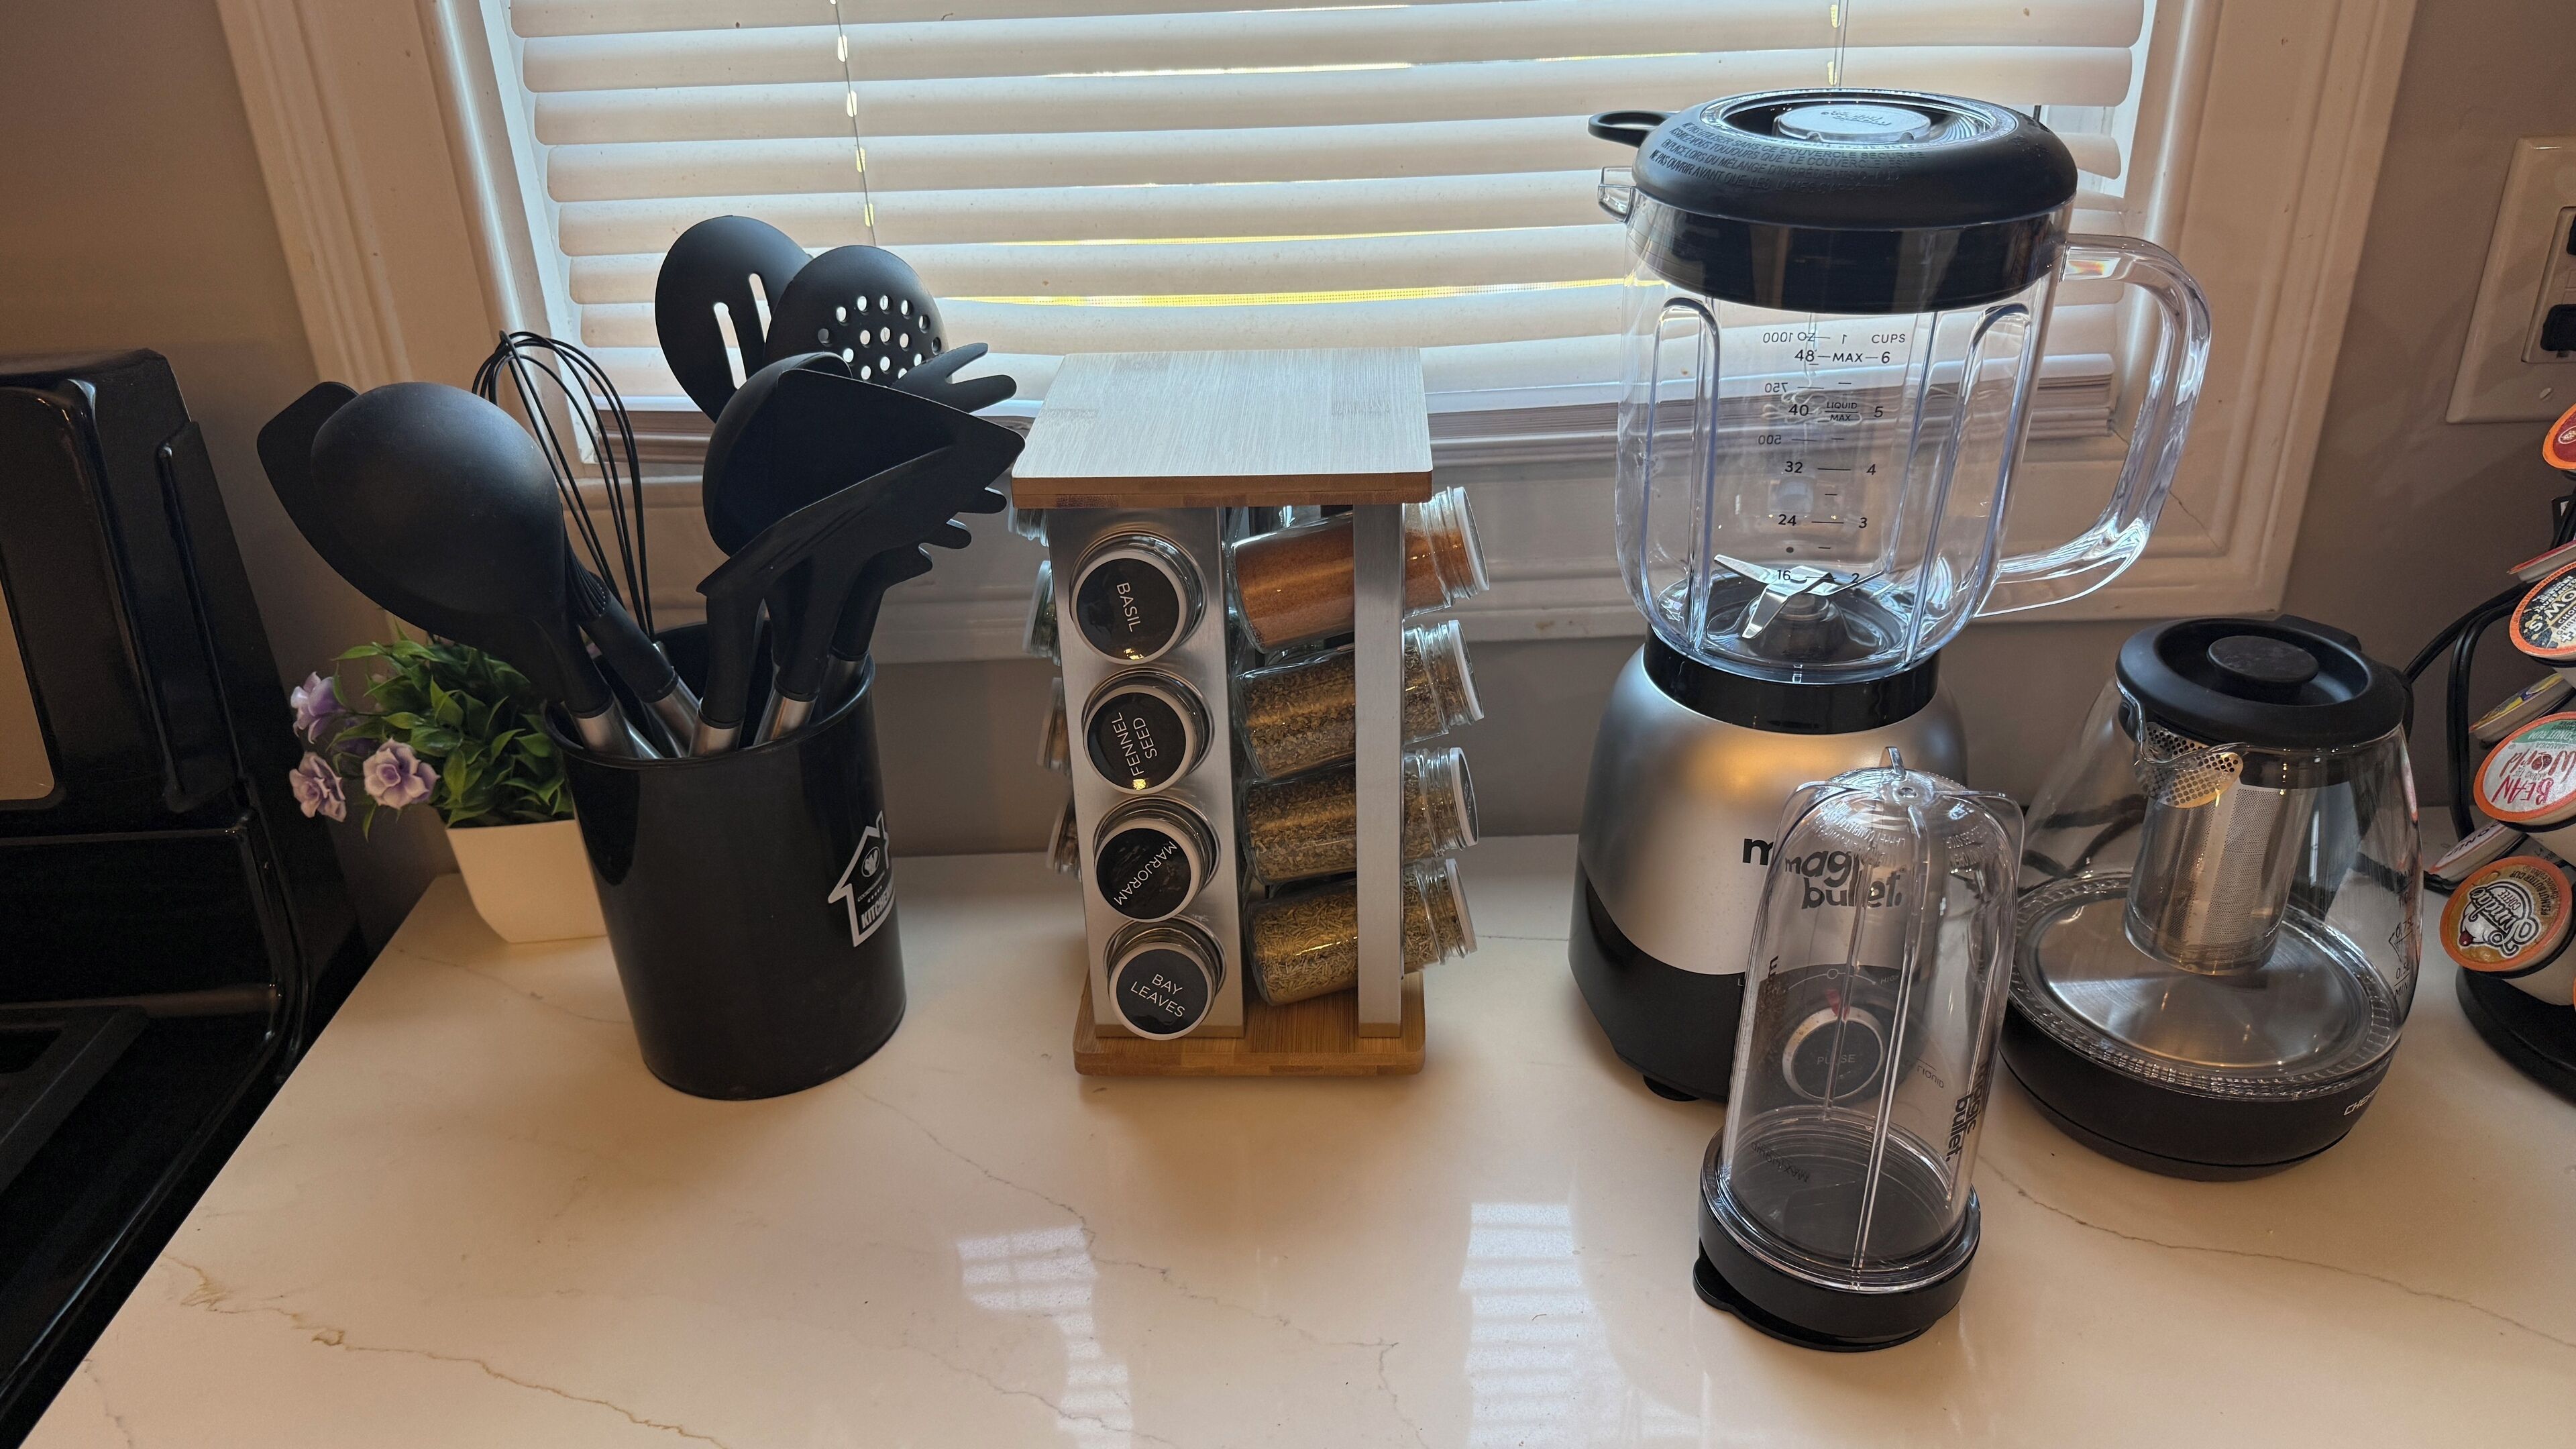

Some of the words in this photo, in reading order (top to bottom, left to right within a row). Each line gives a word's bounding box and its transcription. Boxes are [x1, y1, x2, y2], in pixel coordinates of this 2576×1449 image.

[1684, 148, 1708, 162] LORS
[1705, 154, 1721, 165] DU
[1709, 144, 1760, 160] TOUJOURS
[1760, 152, 1784, 162] QUE
[1789, 155, 1805, 164] LE
[1807, 157, 1880, 168] COUVERCLE
[1731, 140, 1762, 150] SANS
[1762, 144, 1778, 153] CE
[1780, 147, 1857, 159] COUVERCLE
[1649, 149, 1661, 162] NE
[1655, 153, 1671, 166] PAS
[1666, 158, 1696, 176] OUVRIR
[1692, 166, 1725, 182] AVANT
[1723, 171, 1748, 187] QUE
[1797, 331, 1816, 342] OZ
[1871, 333, 1906, 343] CUPS
[1794, 349, 1815, 362] 48
[1832, 352, 1863, 363] MAX
[1881, 351, 1891, 364] 6
[1788, 404, 1809, 417] 40
[1874, 406, 1884, 419] 5
[1829, 414, 1851, 422] MAX
[1784, 460, 1804, 474] 32
[1866, 463, 1877, 476] 4
[1778, 513, 1797, 527] 24
[1858, 517, 1868, 529] 3
[1776, 569, 1792, 581] 16
[1850, 572, 1860, 584] 2
[1116, 582, 1141, 633] BASIL
[1111, 711, 1144, 777] FENNEL
[1132, 716, 1158, 759] SEED
[2491, 774, 2555, 806] BEAN
[1113, 840, 1179, 906] MARJORAM
[2498, 889, 2522, 910] COFFEE
[1151, 973, 1183, 996] BAY
[2394, 980, 2408, 998] MIN
[1130, 981, 1186, 1018] LEAVES
[1816, 1053, 1856, 1066] PUSE
[2343, 1083, 2381, 1116] CHEF
